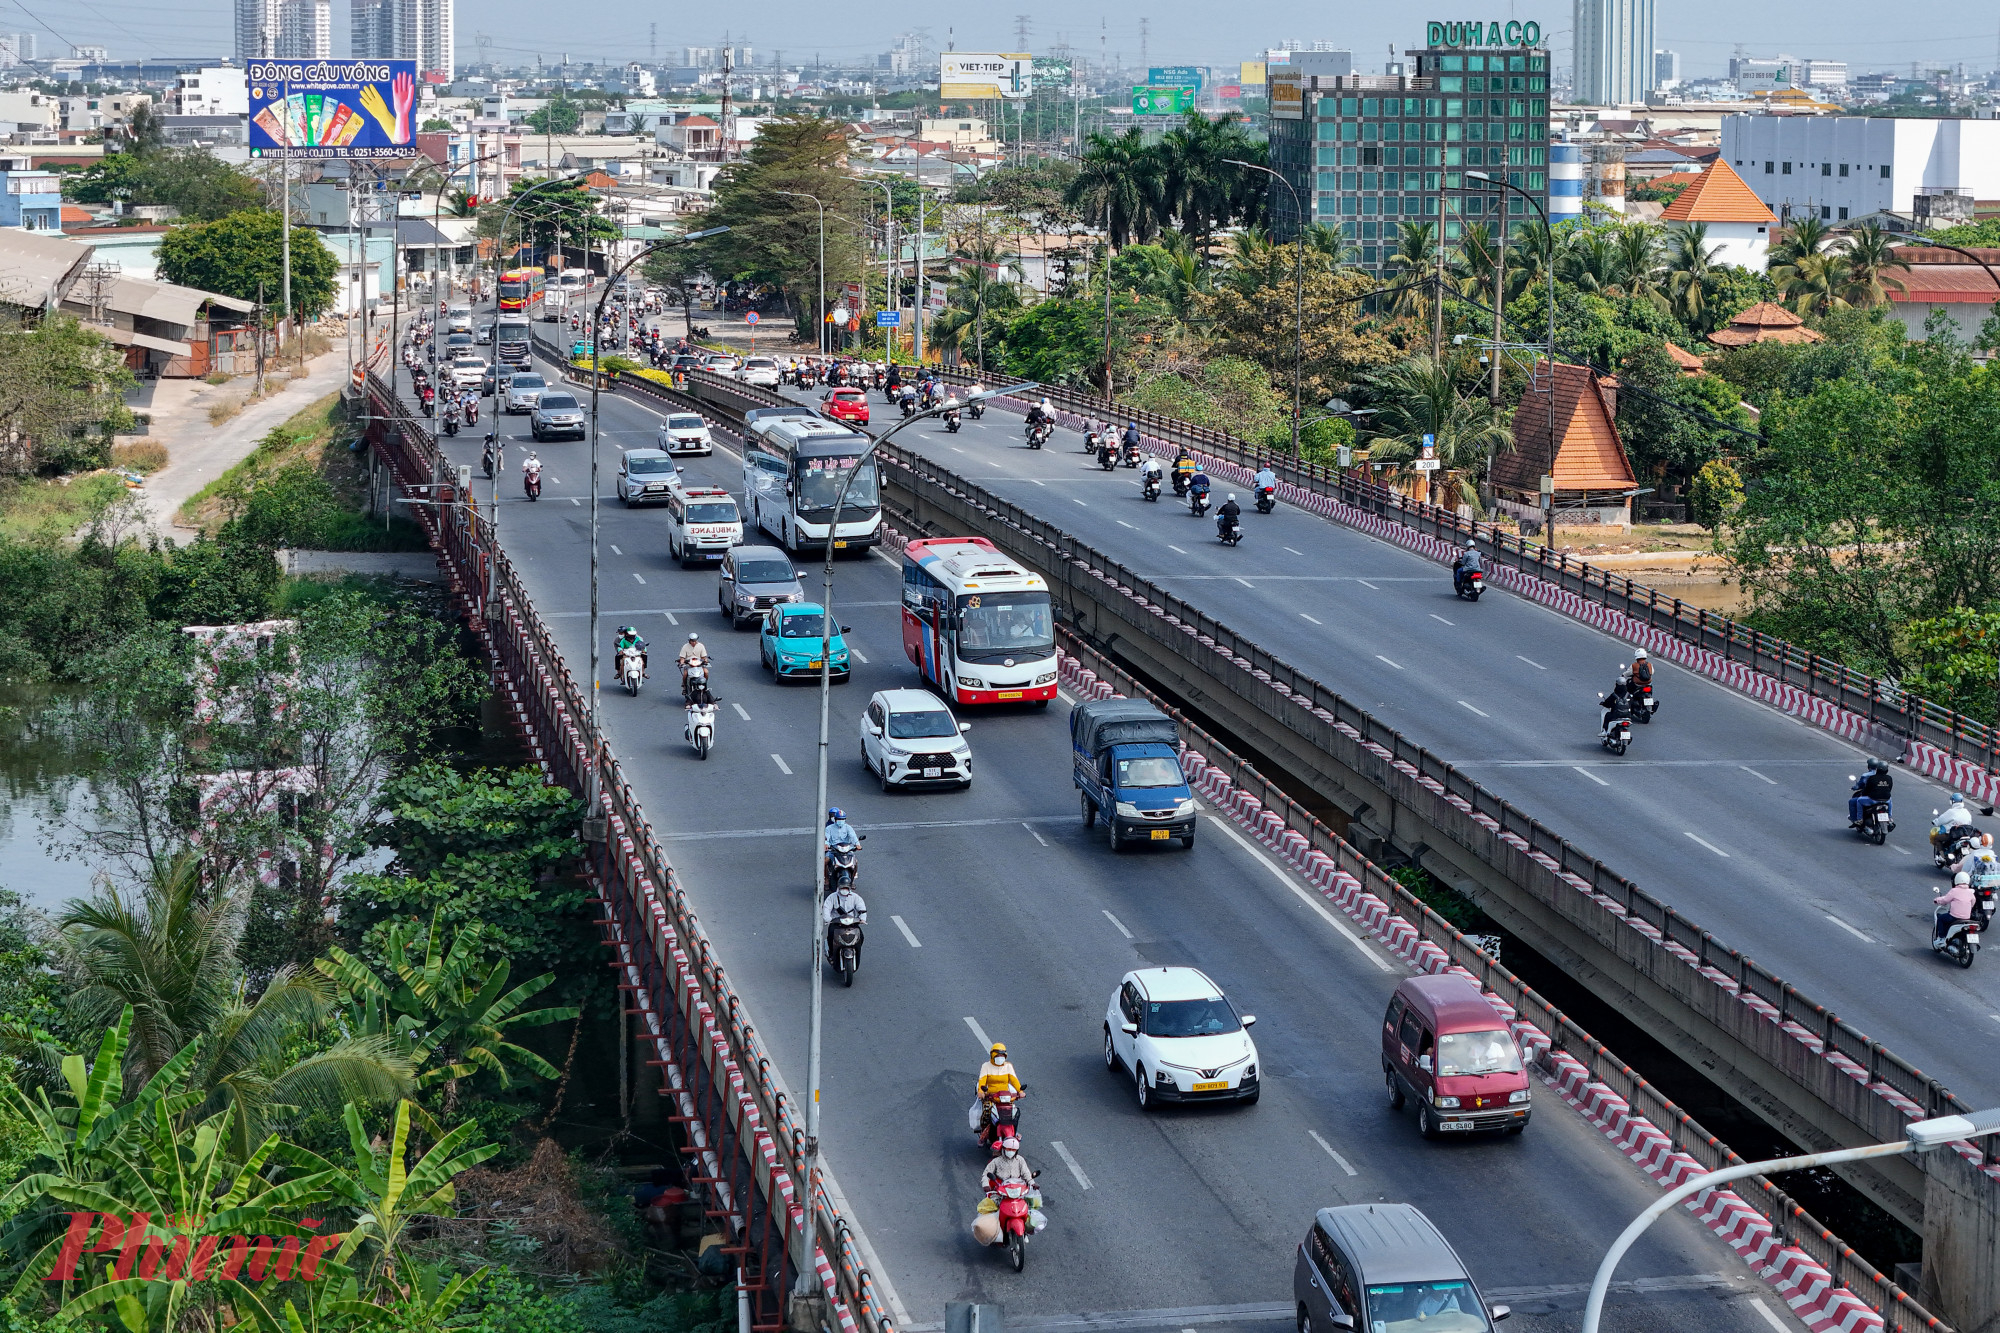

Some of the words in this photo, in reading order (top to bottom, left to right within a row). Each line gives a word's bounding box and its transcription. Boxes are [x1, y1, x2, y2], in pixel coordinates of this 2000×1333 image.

[1427, 20, 1540, 46] DUHACO
[960, 63, 1004, 72] VIET-TIEP
[291, 82, 360, 90] www.whiteglove.com.vn
[1422, 461, 1435, 469] 200
